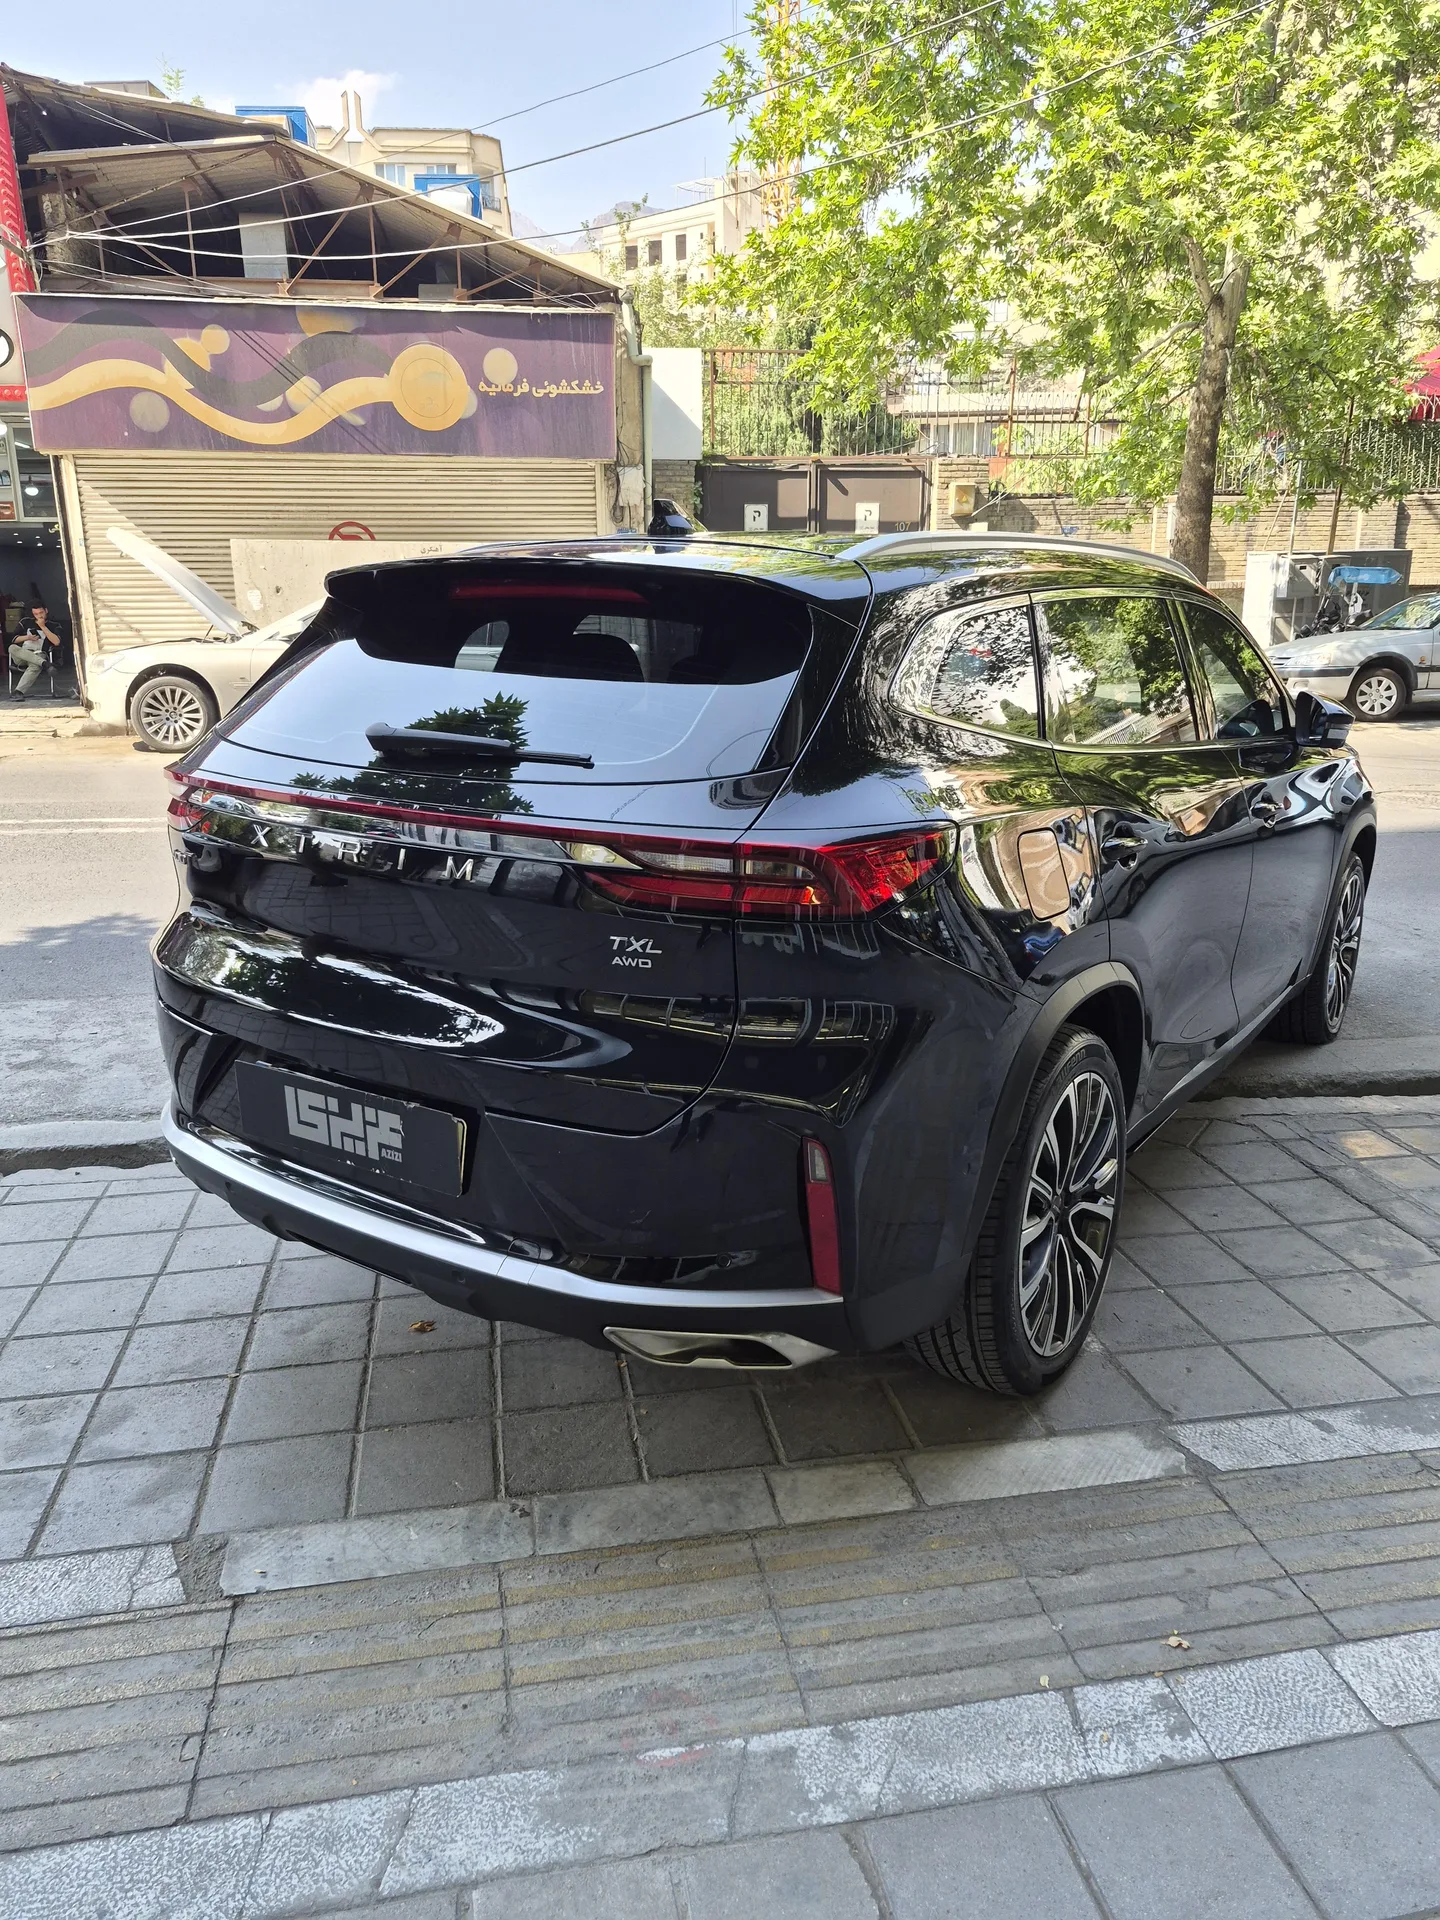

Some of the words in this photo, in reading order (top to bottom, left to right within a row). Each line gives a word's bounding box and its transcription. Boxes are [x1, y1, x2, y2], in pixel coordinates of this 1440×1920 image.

[895, 521, 911, 532] 107
[251, 823, 475, 881] XTRIM
[609, 935, 662, 954] TXL
[611, 955, 652, 968] AWD
